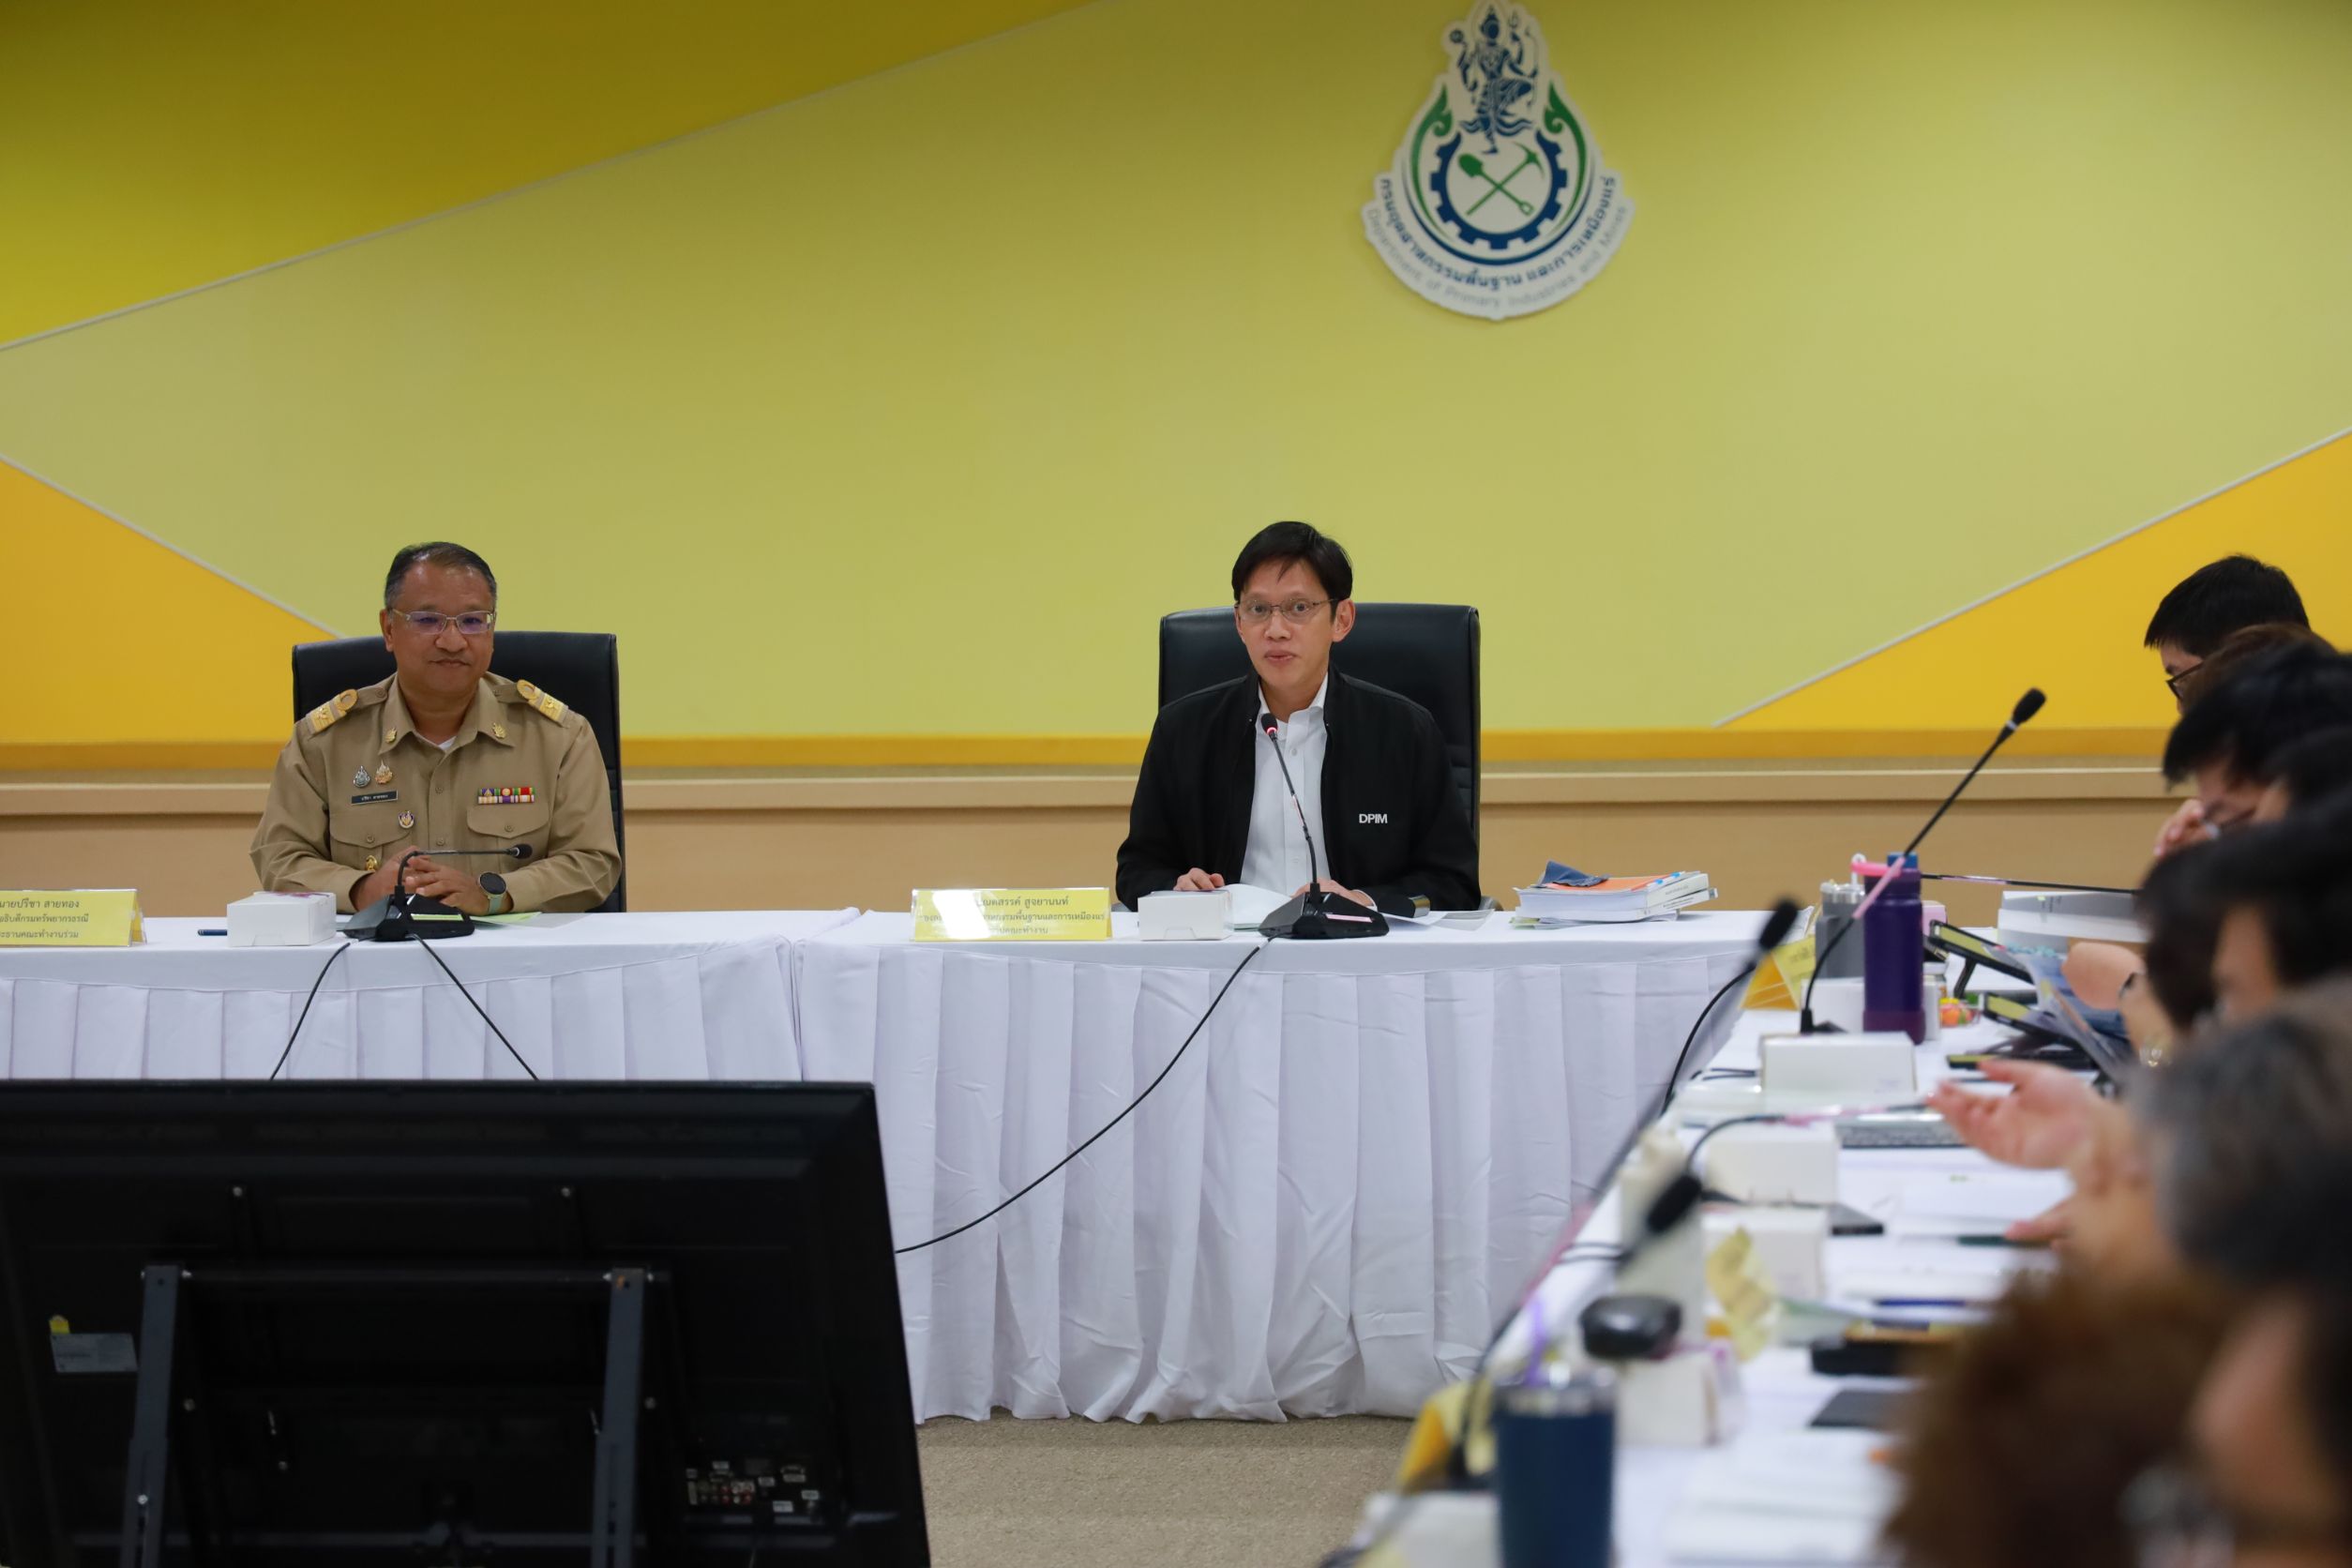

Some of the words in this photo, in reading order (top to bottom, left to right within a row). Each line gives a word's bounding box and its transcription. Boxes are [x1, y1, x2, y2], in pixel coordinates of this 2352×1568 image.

[1358, 813, 1388, 824] DPIM
[43, 899, 80, 909] สายทอง
[0, 928, 79, 939] ะธานคณะทำงานร่วม
